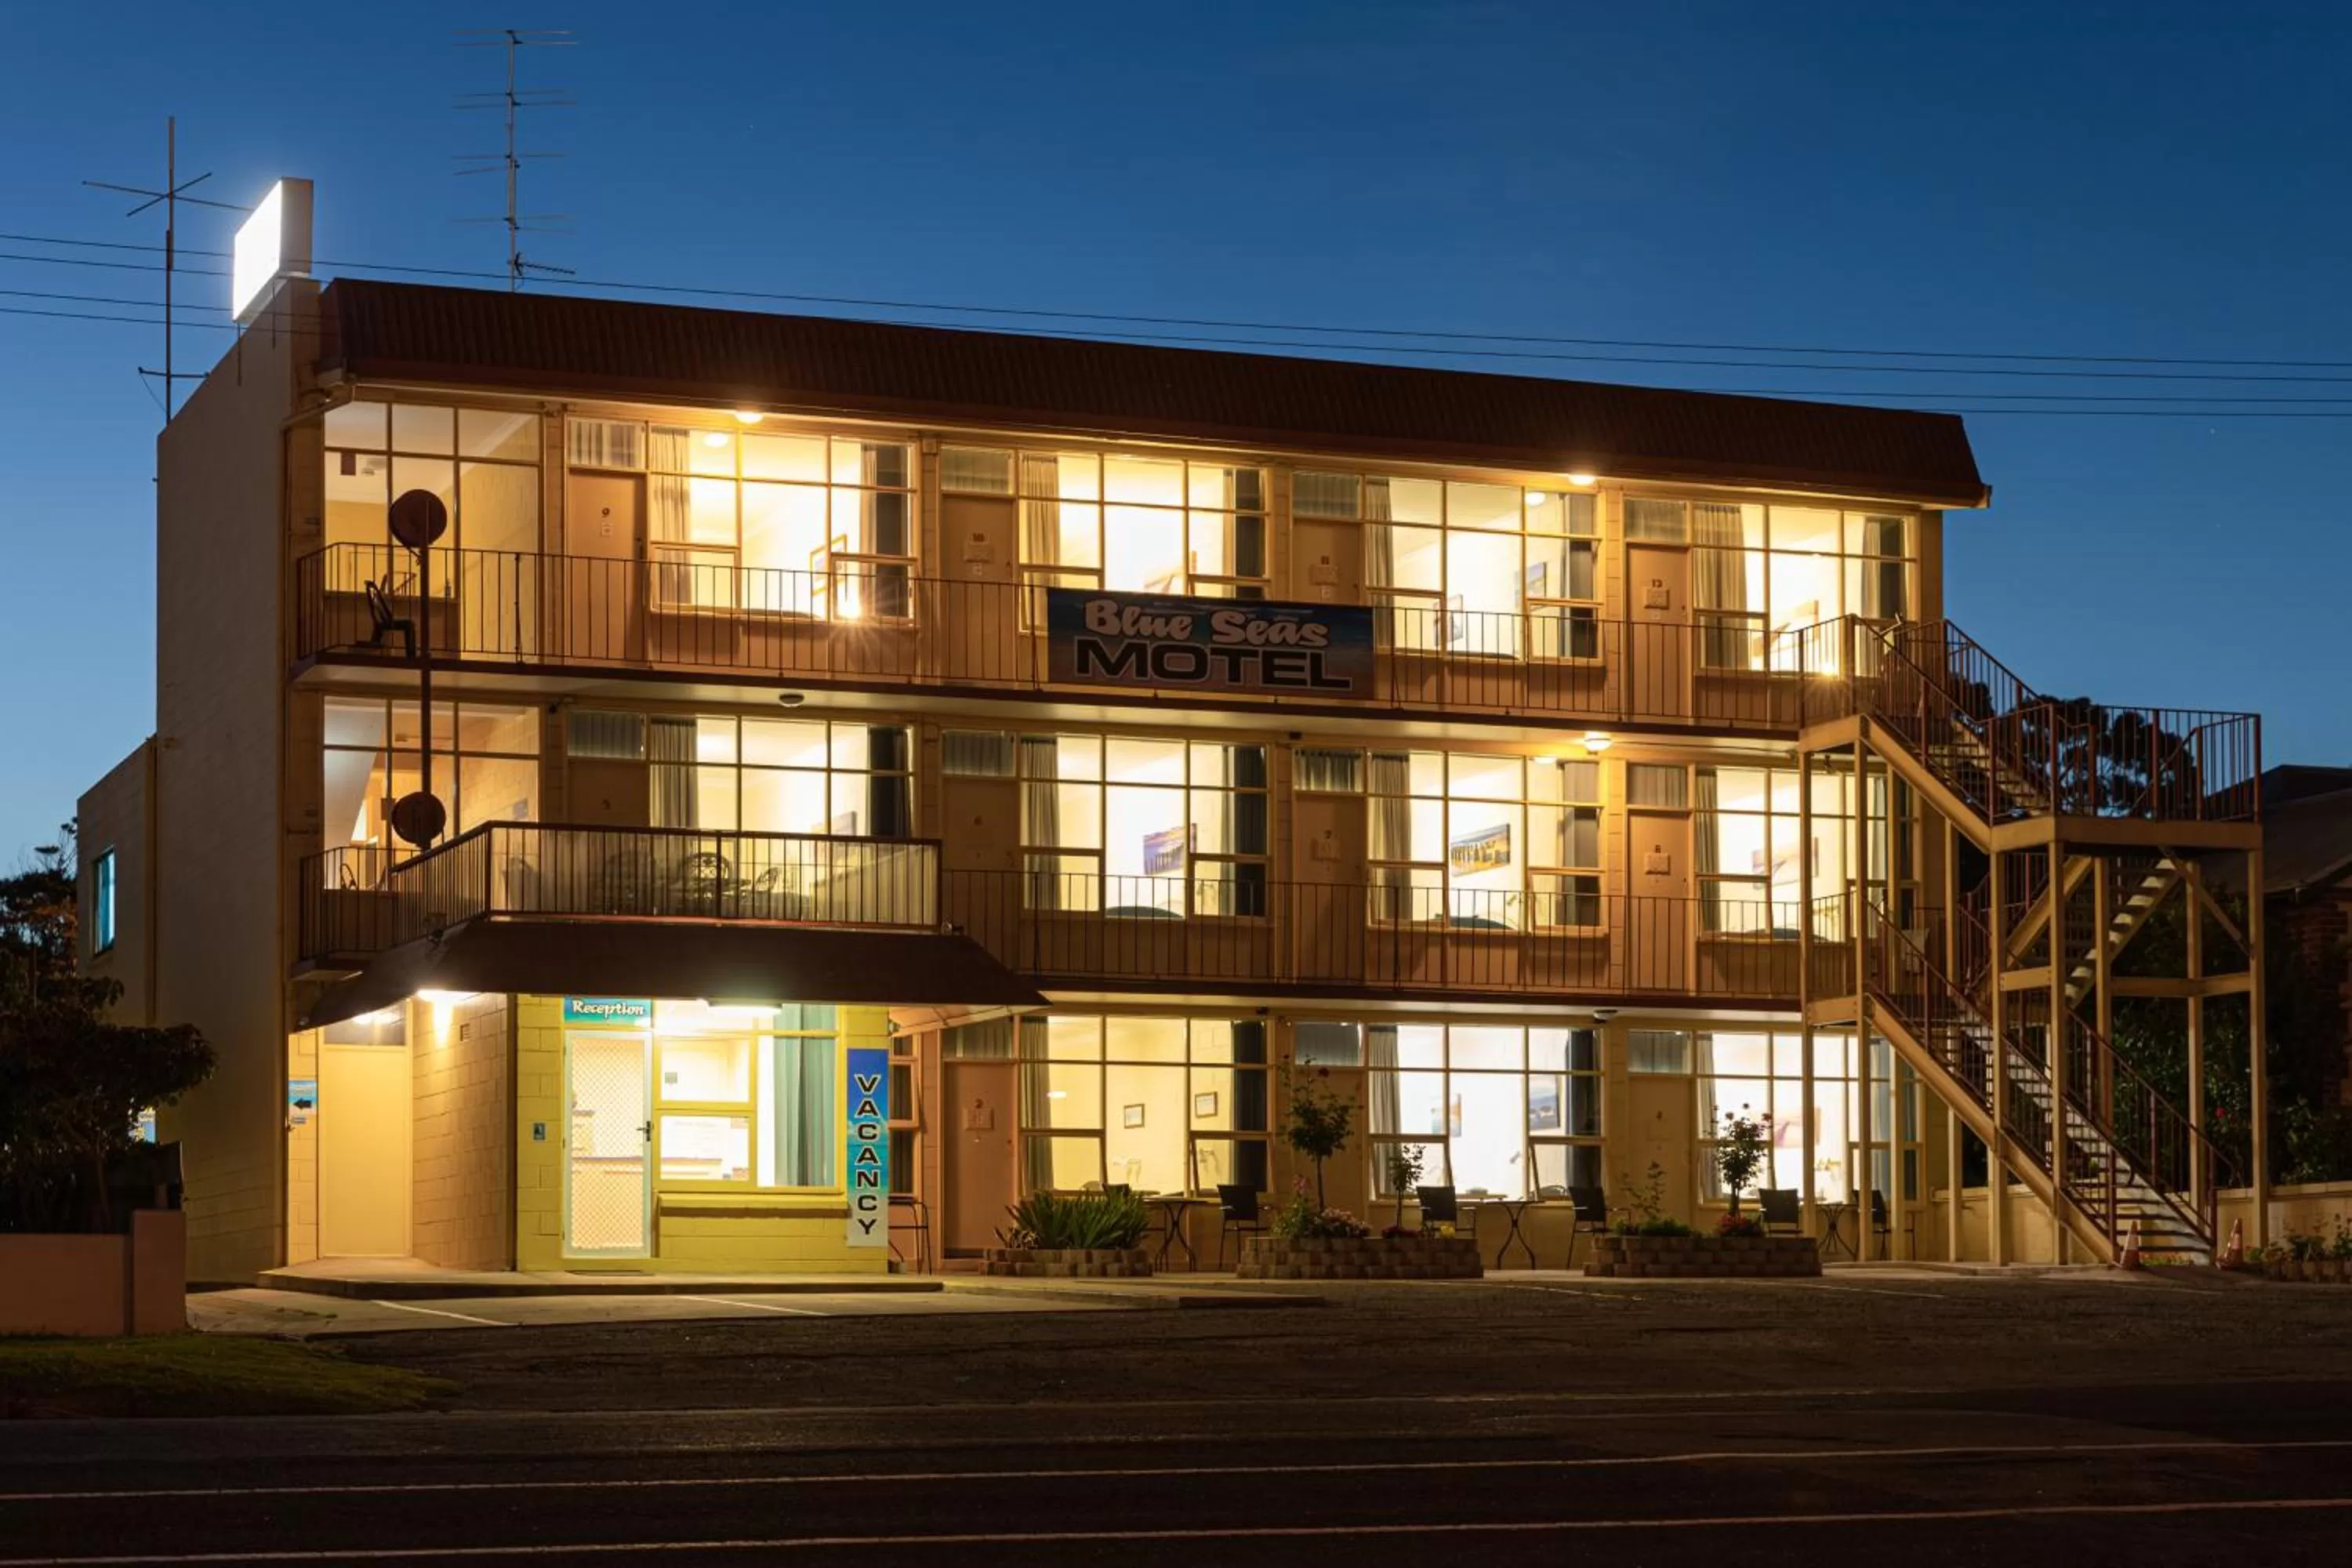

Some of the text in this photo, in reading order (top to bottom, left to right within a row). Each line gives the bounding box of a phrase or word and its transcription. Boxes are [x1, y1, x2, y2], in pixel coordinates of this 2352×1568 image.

[601, 507, 610, 518] 9
[1085, 599, 1329, 647] Blue Seas
[1075, 636, 1352, 690] MOTEL
[572, 1000, 644, 1018] Reception
[854, 1073, 882, 1236] VACANCY
